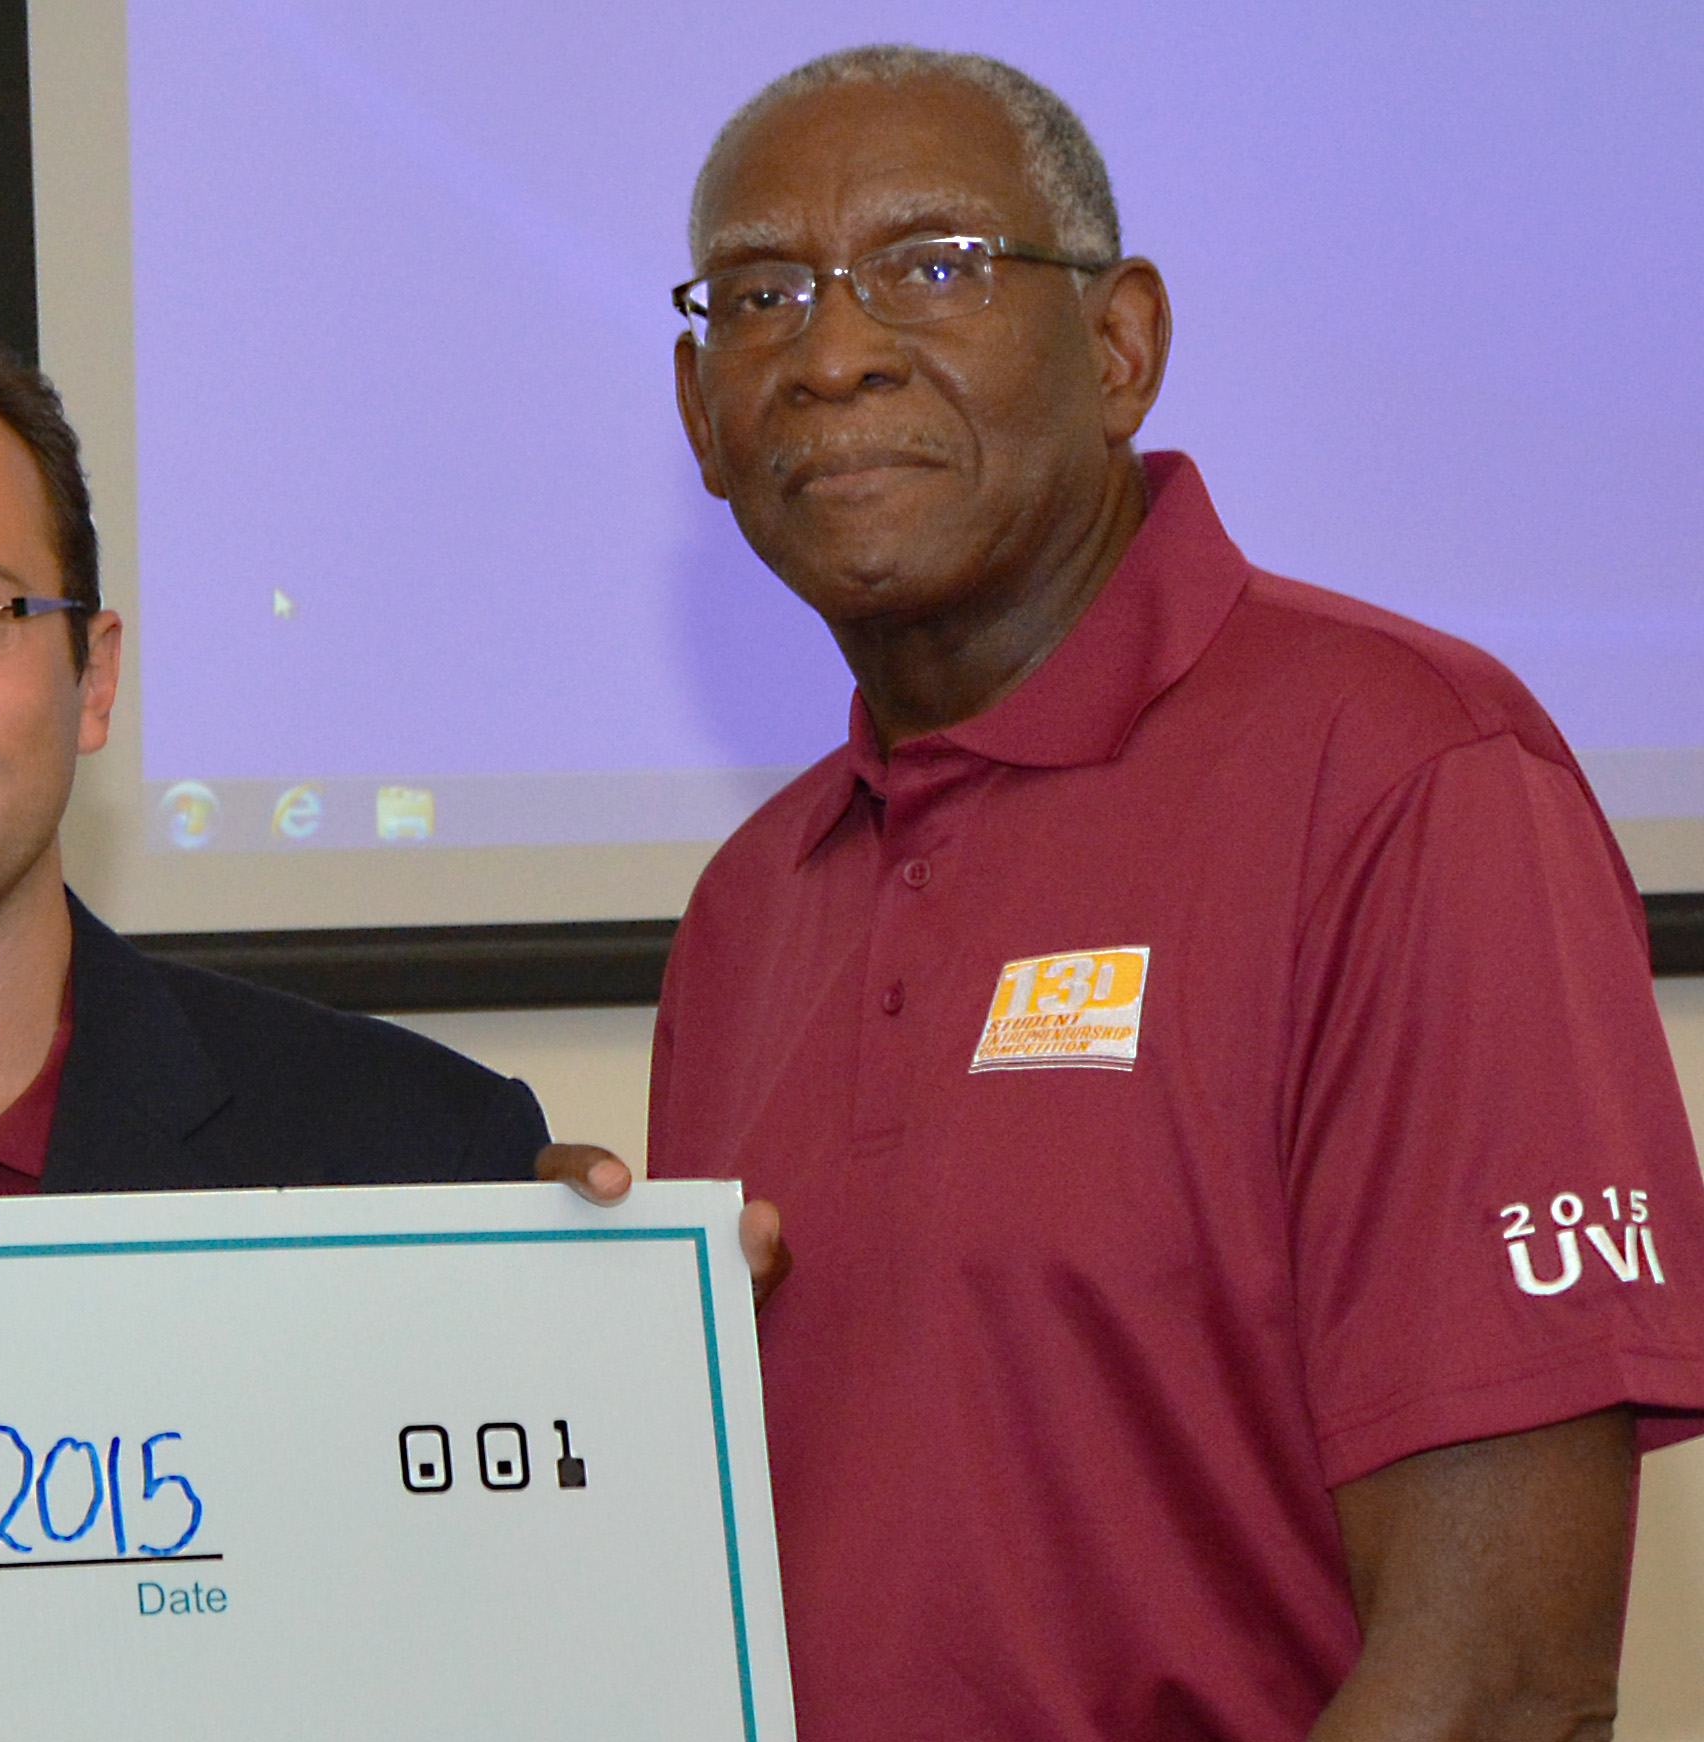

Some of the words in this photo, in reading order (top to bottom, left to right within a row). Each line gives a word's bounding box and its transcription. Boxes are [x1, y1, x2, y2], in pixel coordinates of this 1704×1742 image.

[1499, 1185, 1649, 1240] 2015
[1507, 1222, 1666, 1297] UVI
[398, 1419, 589, 1496] 001
[137, 1581, 230, 1617] Date
